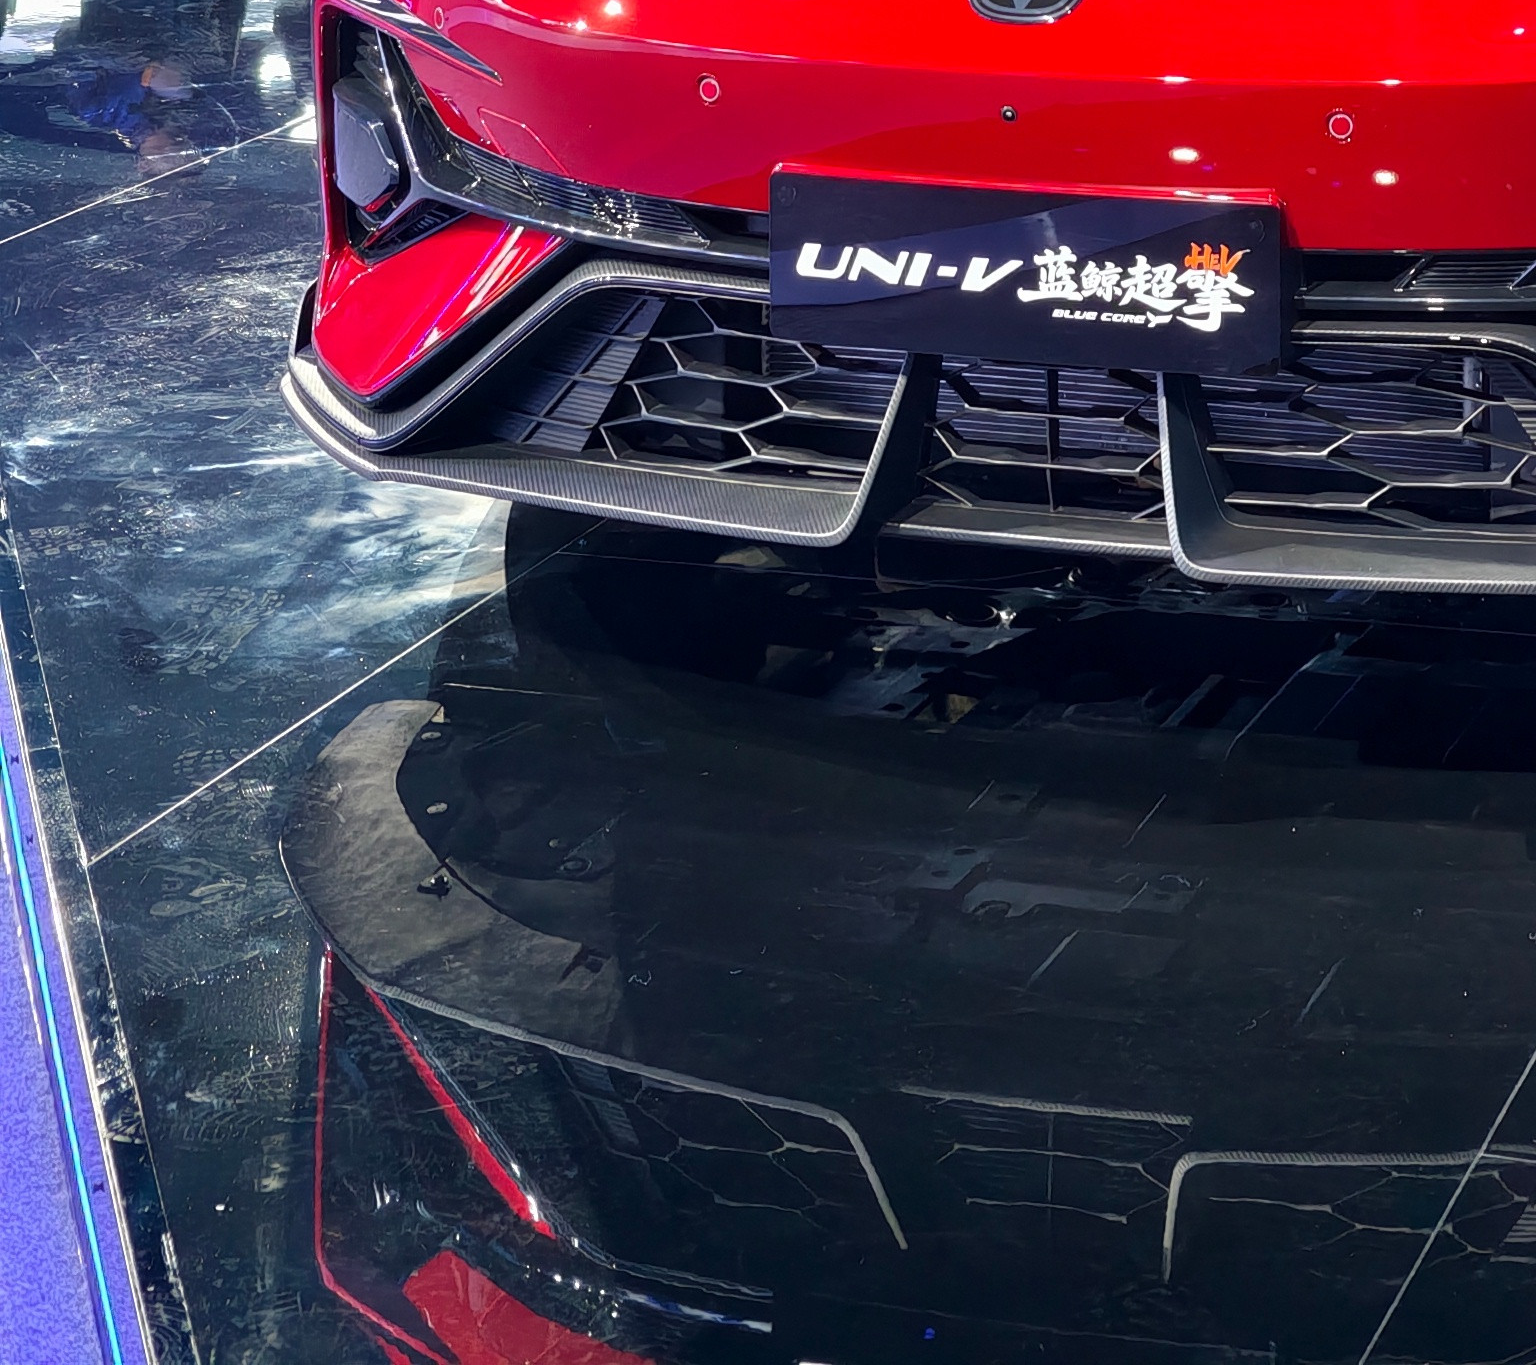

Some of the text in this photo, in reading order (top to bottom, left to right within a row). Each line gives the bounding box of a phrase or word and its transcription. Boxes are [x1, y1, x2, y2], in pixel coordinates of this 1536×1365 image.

[1184, 242, 1251, 277] HEV
[796, 242, 1255, 332] UNI-V 蓝鲸超擎
[1052, 308, 1147, 325] BLUE CORE
